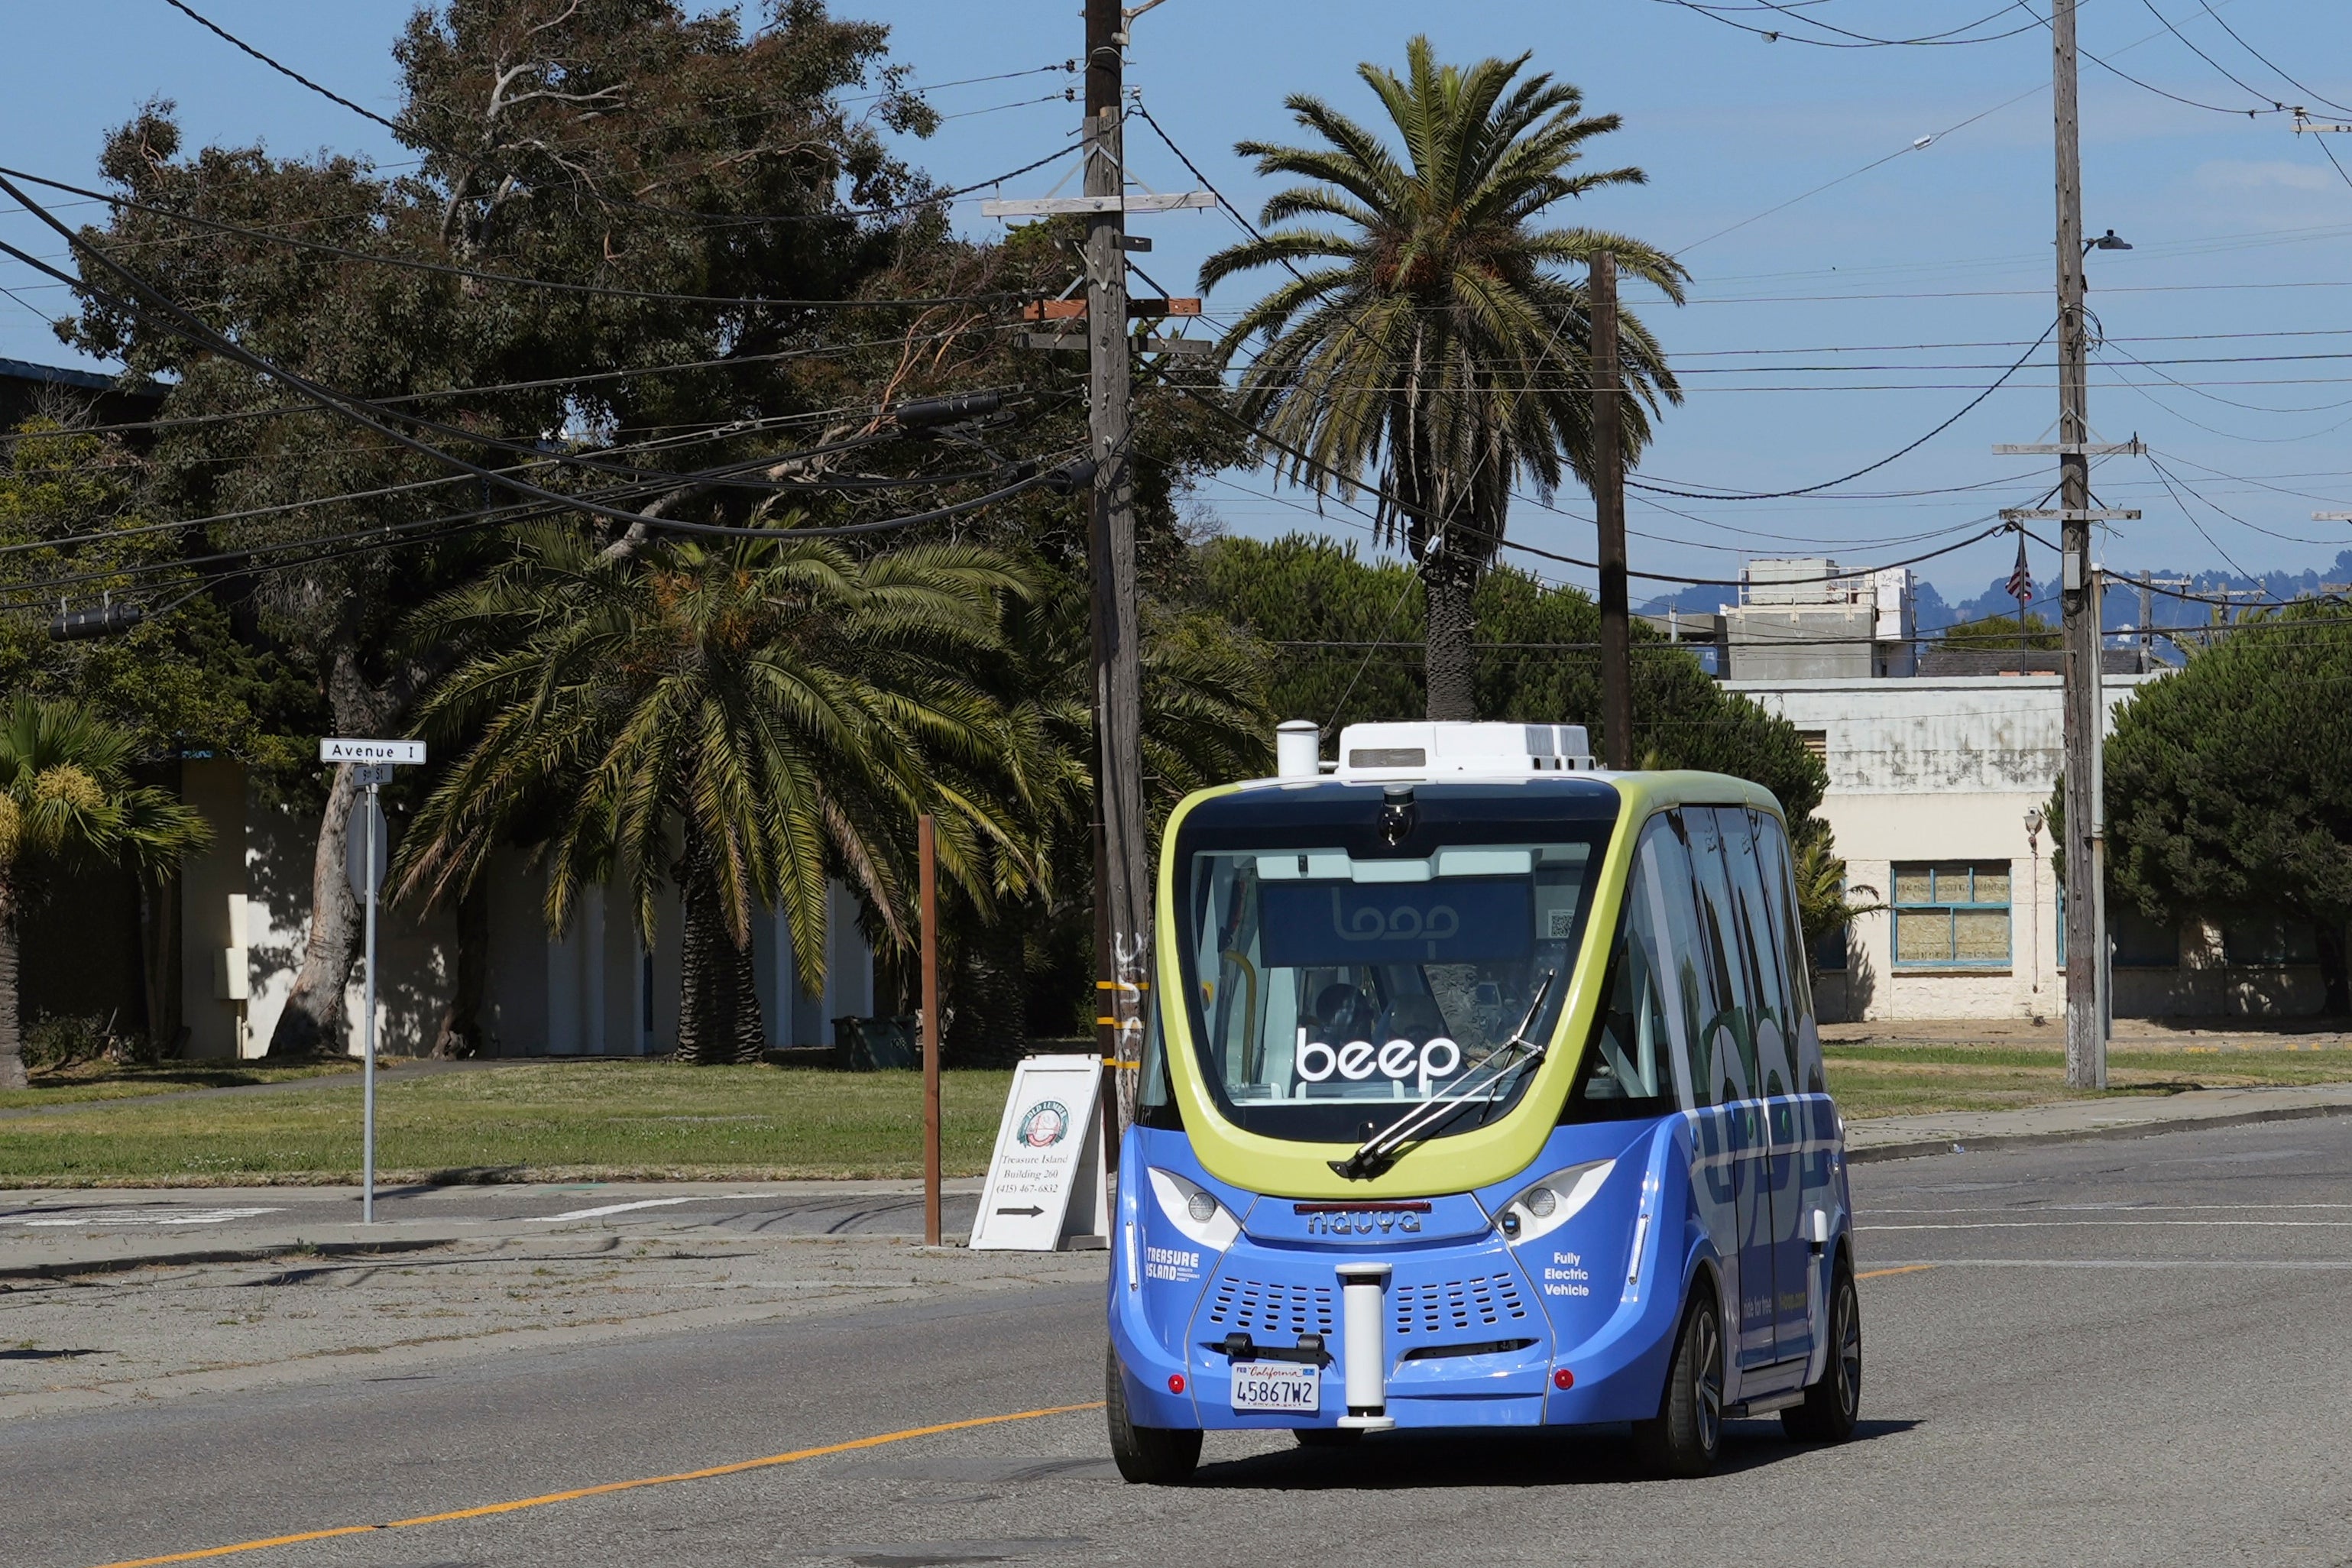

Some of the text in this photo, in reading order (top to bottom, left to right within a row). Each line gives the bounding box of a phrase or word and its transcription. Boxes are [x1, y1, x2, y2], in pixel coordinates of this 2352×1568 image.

[332, 744, 413, 758] Avenue I
[1296, 1028, 1460, 1093] beep
[1002, 1155, 1068, 1164] Treasure Island
[1003, 1169, 1058, 1181] Building 260
[996, 1184, 1017, 1194] (415)
[1147, 1246, 1200, 1268] TREASURE
[1553, 1252, 1581, 1267] Fully
[1146, 1262, 1177, 1281] ISLAND
[1544, 1268, 1589, 1280] Electric
[1544, 1284, 1589, 1297] Vehicle
[1249, 1366, 1303, 1380] California
[1237, 1381, 1312, 1403] 45867W2
